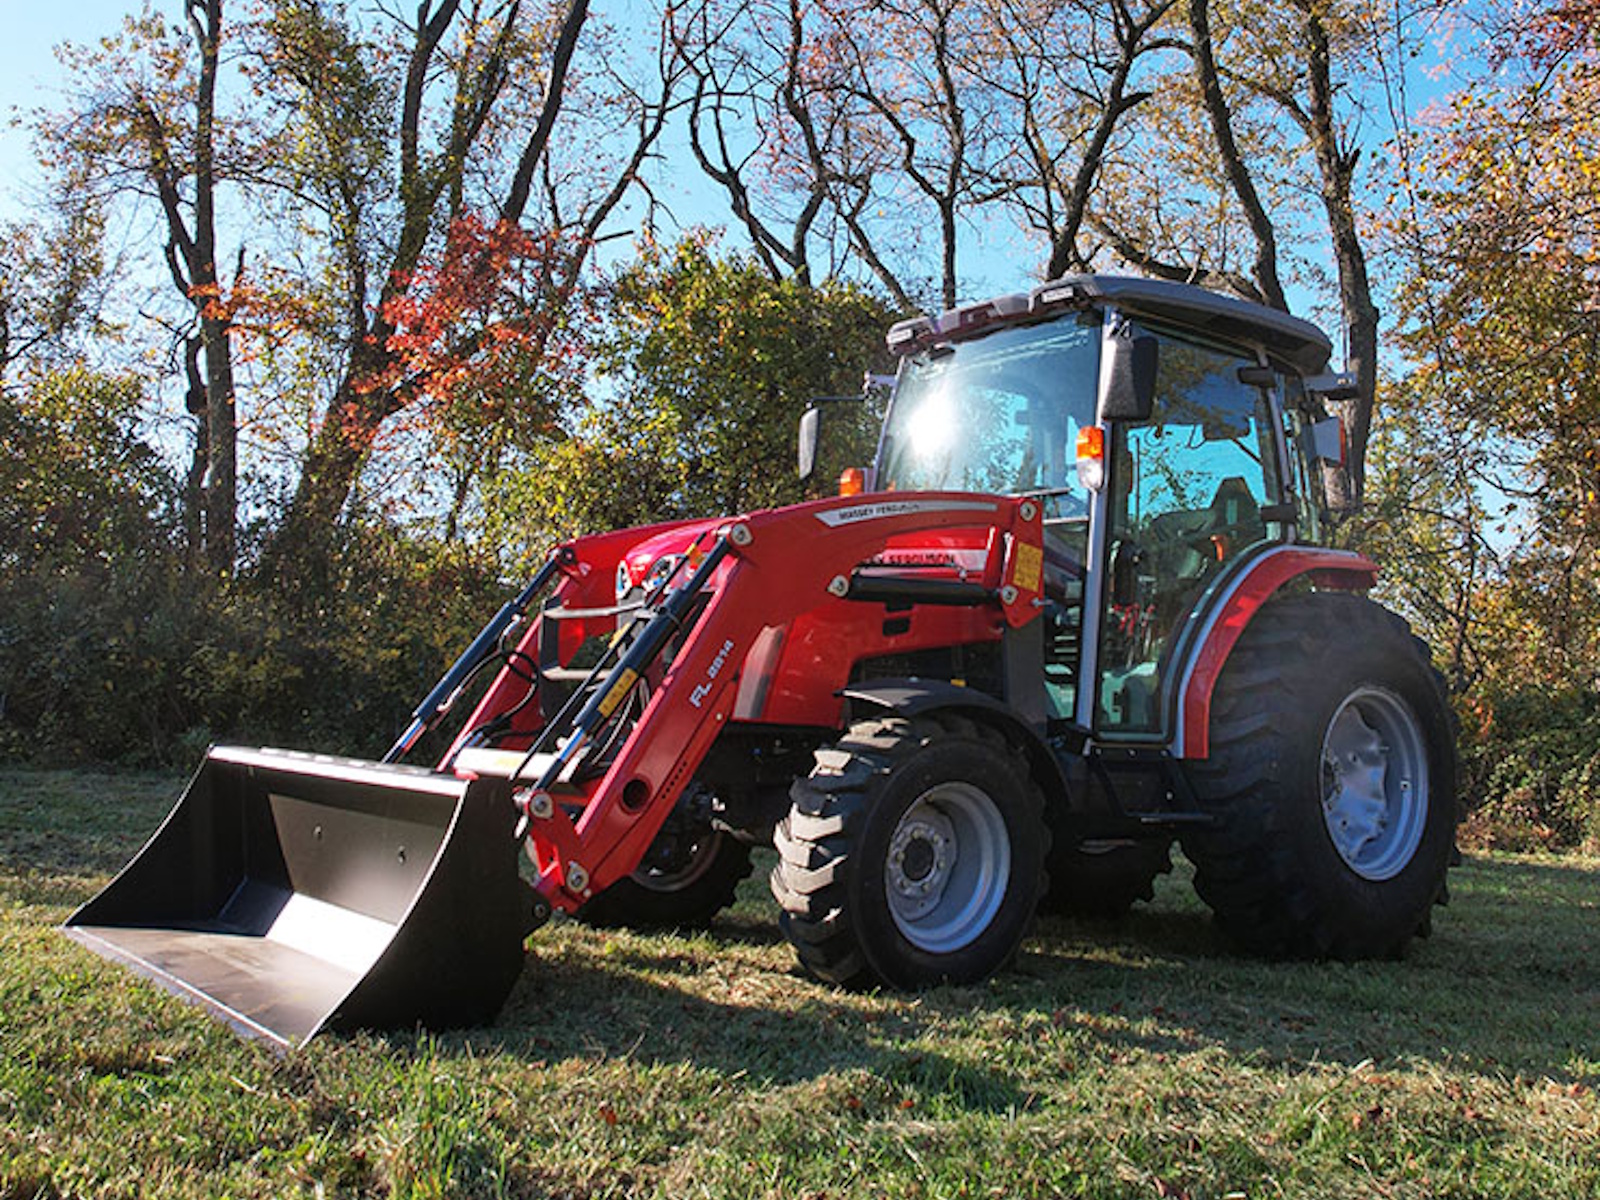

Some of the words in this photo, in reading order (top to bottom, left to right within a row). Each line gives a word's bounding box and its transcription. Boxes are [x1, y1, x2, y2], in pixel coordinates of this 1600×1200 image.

[838, 506, 873, 520] MASSEY
[888, 552, 955, 565] FERGUSON
[689, 682, 713, 708] FL
